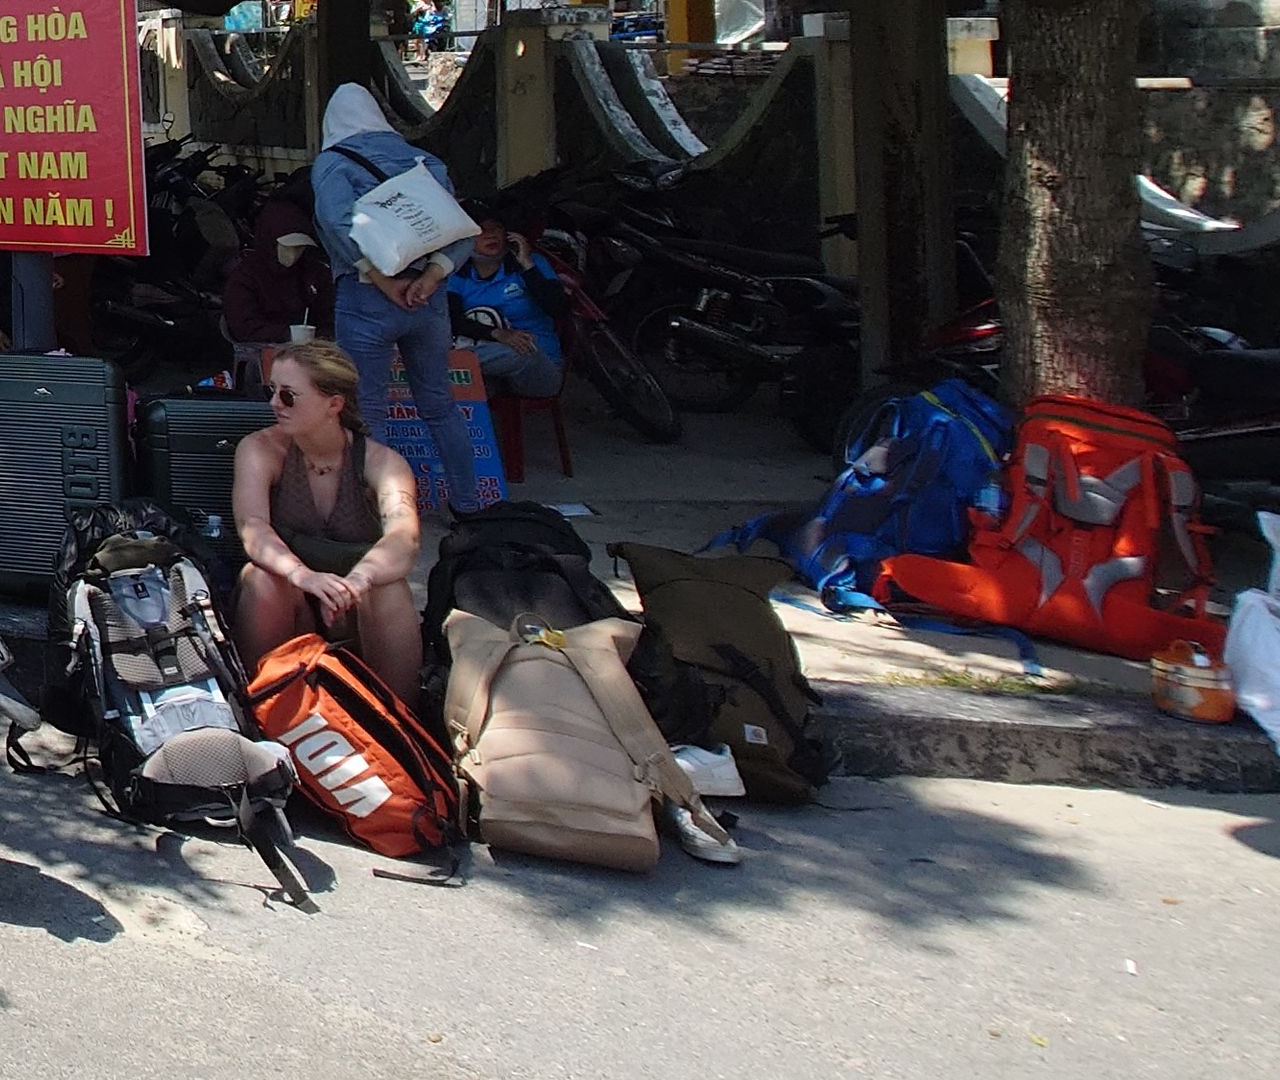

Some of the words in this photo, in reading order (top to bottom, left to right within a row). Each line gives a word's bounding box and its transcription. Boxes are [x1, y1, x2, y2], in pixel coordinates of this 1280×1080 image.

[27, 7, 87, 40] HÒA
[13, 54, 62, 92] HỘI
[4, 99, 97, 133] NGHĨA
[18, 151, 88, 179] NAM
[23, 192, 94, 227] NĂM
[104, 199, 115, 227] !
